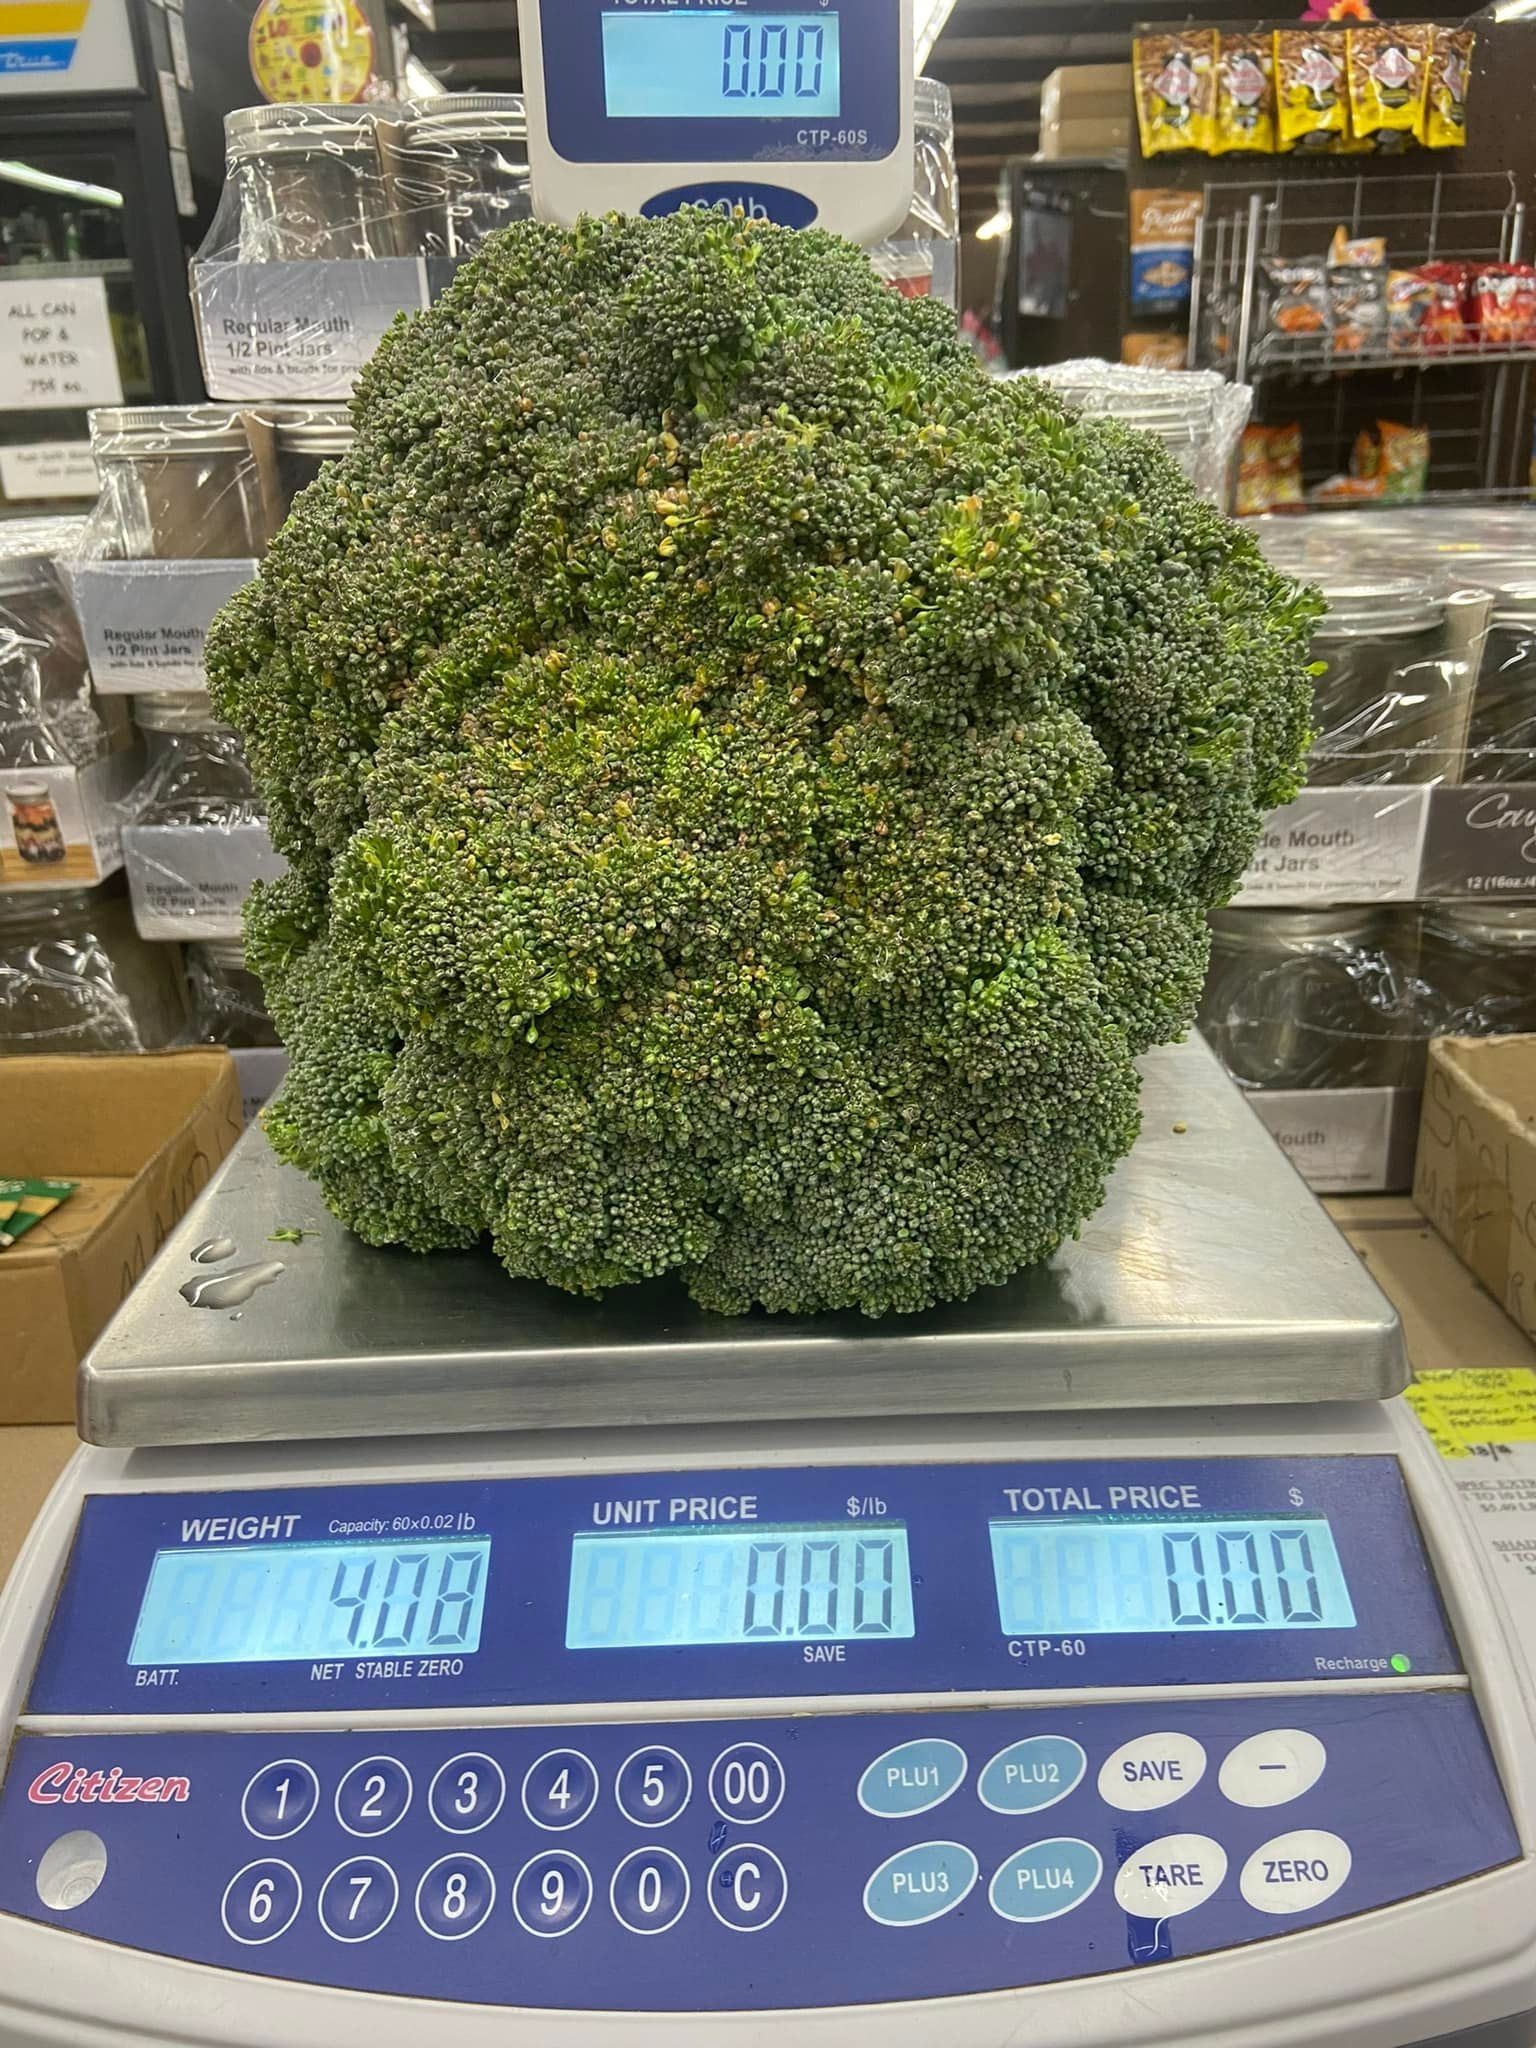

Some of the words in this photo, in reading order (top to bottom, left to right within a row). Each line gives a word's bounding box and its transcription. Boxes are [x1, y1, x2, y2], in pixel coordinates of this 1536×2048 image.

[722, 25, 824, 97] 0.00
[796, 130, 868, 145] CTP-60S
[223, 318, 291, 339] Regular
[295, 315, 350, 335] Mouth
[227, 340, 252, 358] 1/2
[103, 628, 157, 643] Regular
[160, 627, 205, 641] Mouth
[131, 644, 158, 656] Pint
[163, 643, 192, 656] Jars
[1255, 831, 1281, 849] de
[1289, 829, 1355, 848] Mouth
[1249, 856, 1268, 873] nt
[1274, 855, 1320, 873] Jars
[846, 1496, 887, 1517] $/lb
[1003, 1486, 1101, 1512] TOTAL
[1109, 1484, 1201, 1509] PRICE
[1288, 1486, 1305, 1507] $
[592, 1499, 660, 1525] UNIT
[668, 1496, 758, 1521] PRICE
[181, 1514, 301, 1542] WEIGHT
[328, 1518, 390, 1534] Capacity:
[743, 1539, 894, 1637] 0.00
[1161, 1529, 1324, 1626] 0.00
[329, 1551, 483, 1649] 4.08
[803, 1646, 846, 1663] SAVE
[1007, 1638, 1087, 1658] CTP-60
[135, 1668, 180, 1687] BATT.
[310, 1663, 345, 1681] NET
[355, 1660, 413, 1679] STABLE
[417, 1658, 464, 1677] ZERO
[1315, 1656, 1388, 1673] Recharge
[27, 1760, 191, 1805] Citizen
[723, 1760, 770, 1806] 00
[886, 1763, 940, 1789] PLU1
[1004, 1762, 1061, 1785] PLU2
[1122, 1759, 1184, 1783] SAVE
[275, 1778, 291, 1820] 1
[359, 1774, 386, 1818] 2
[455, 1770, 478, 1815] 3
[548, 1768, 571, 1810] 4
[641, 1764, 665, 1808] 5
[892, 1870, 951, 1894] PLU3
[1016, 1867, 1075, 1890] PLU4
[1138, 1862, 1203, 1887] TARE
[1262, 1858, 1329, 1884] ZERO
[347, 1876, 373, 1921] 7
[441, 1872, 467, 1920] 8
[539, 1869, 566, 1917] 9
[637, 1866, 663, 1914] 0
[732, 1861, 762, 1912] C
[248, 1877, 275, 1924] 6
